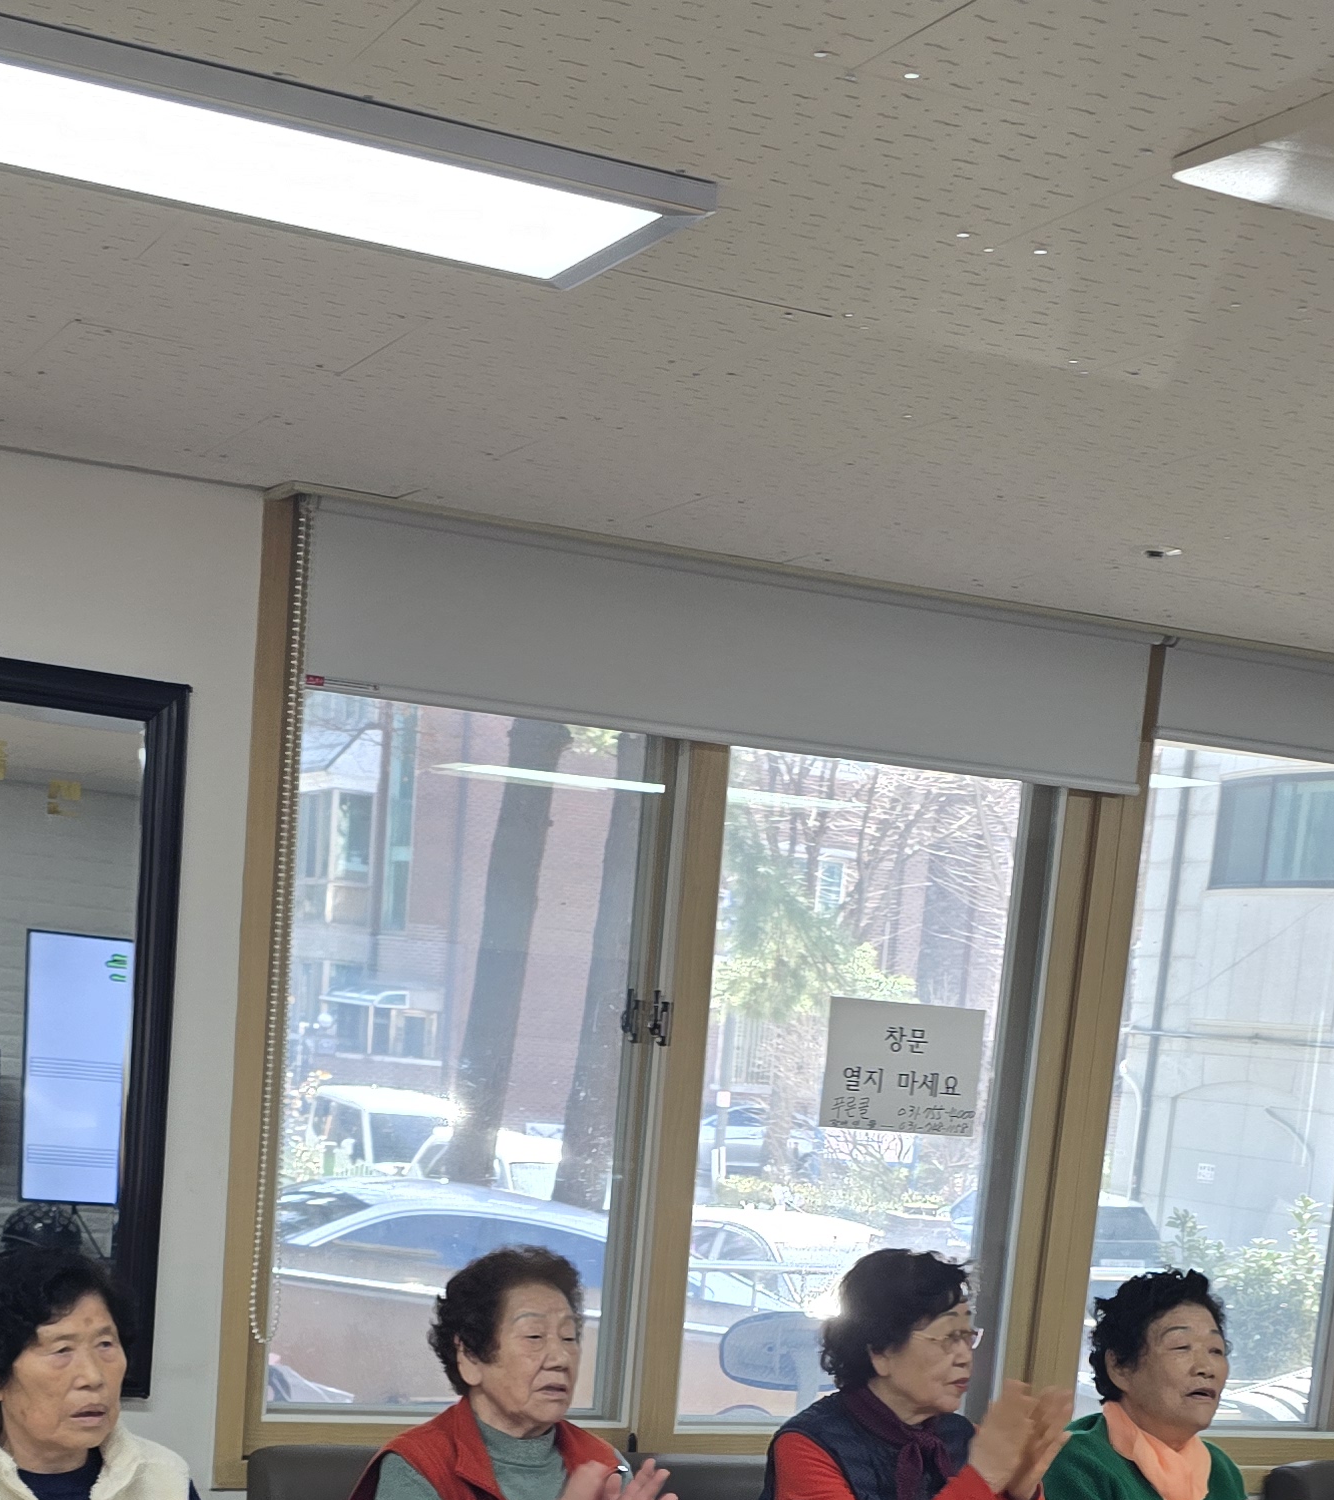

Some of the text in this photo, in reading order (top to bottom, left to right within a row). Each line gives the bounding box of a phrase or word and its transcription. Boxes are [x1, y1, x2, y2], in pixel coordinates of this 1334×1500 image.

[885, 1026, 929, 1054] 창문
[843, 1066, 961, 1098] 열지 마세요
